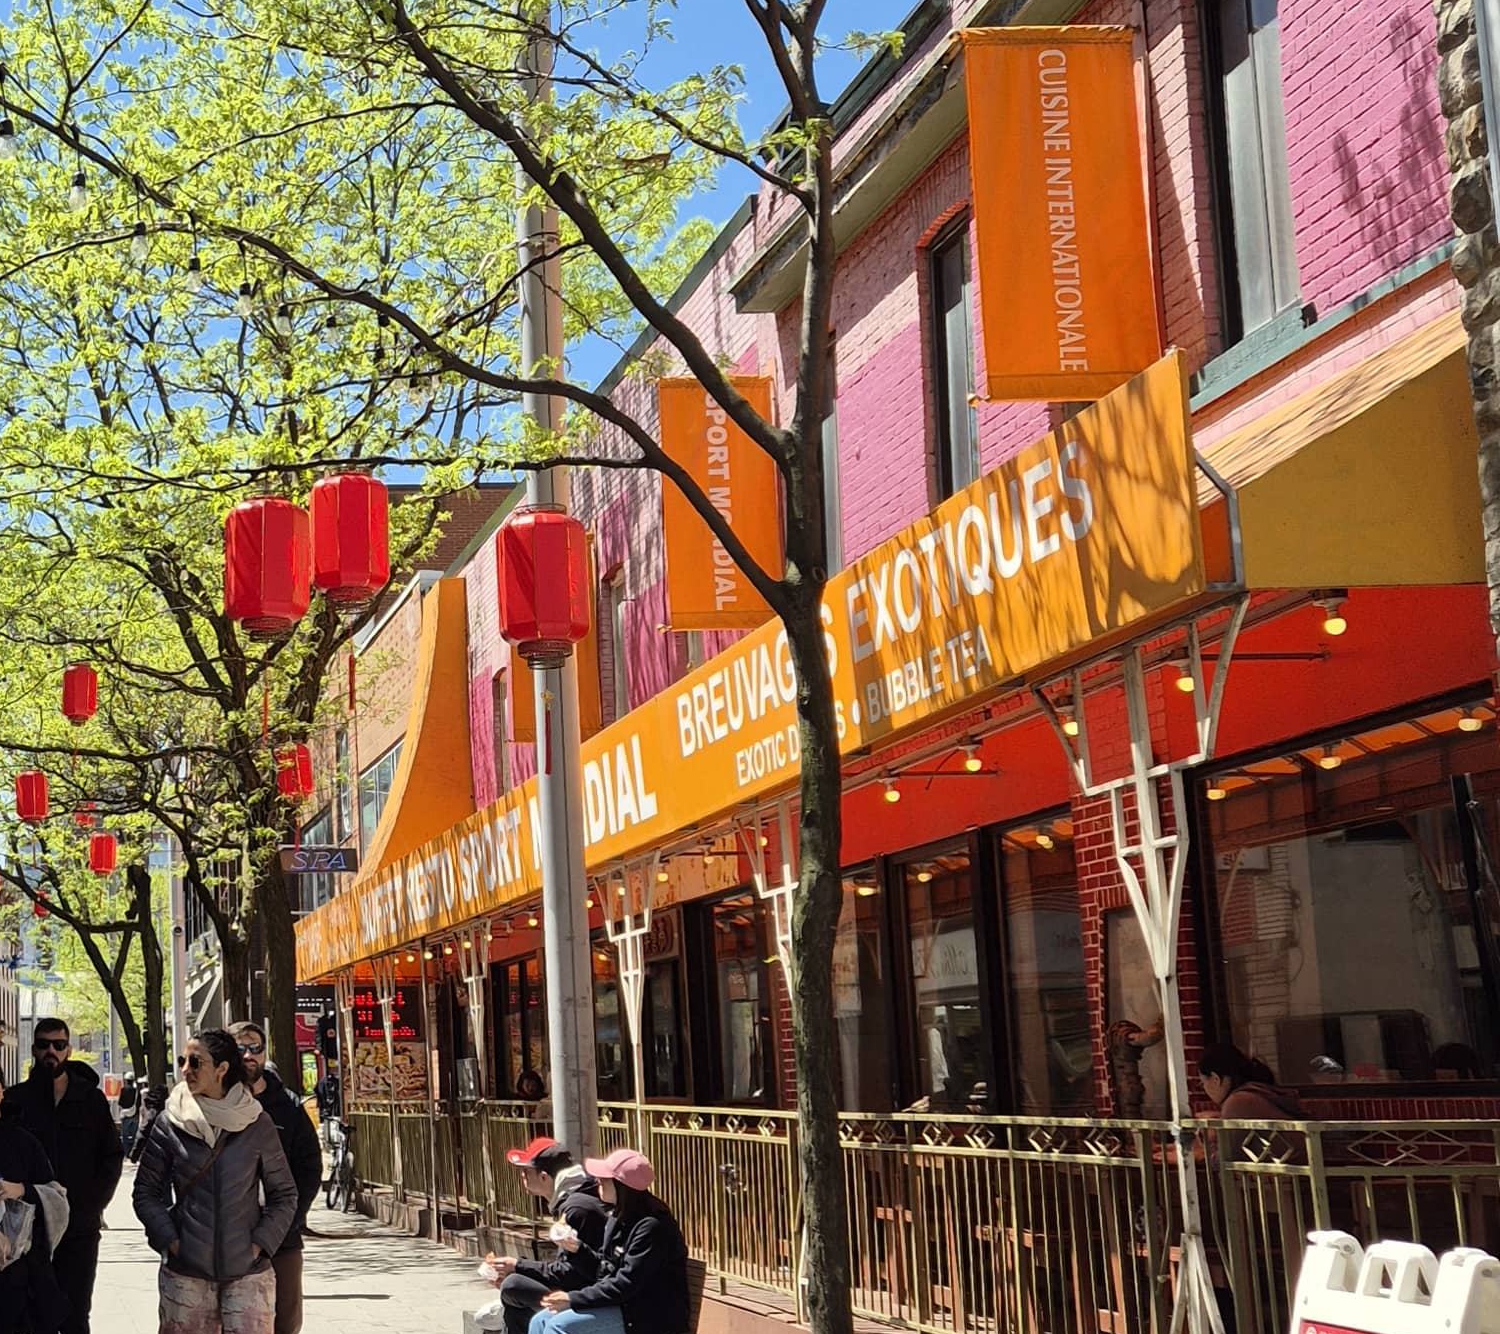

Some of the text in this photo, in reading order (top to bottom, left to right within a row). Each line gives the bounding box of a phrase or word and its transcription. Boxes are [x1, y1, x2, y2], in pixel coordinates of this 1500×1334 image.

[1038, 48, 1070, 152] CUISINE
[1043, 157, 1089, 373] INTERNATIONALE
[676, 440, 1094, 759] BREUVAGS EXOTIQUES
[708, 485, 738, 612] MDIAL
[866, 623, 994, 725] BUBBLE TEA
[735, 730, 788, 788] EXOTIC
[291, 849, 347, 872] SPA
[405, 846, 456, 927] RESTO
[457, 807, 522, 904] SPORT
[528, 732, 658, 872] MDIAL
